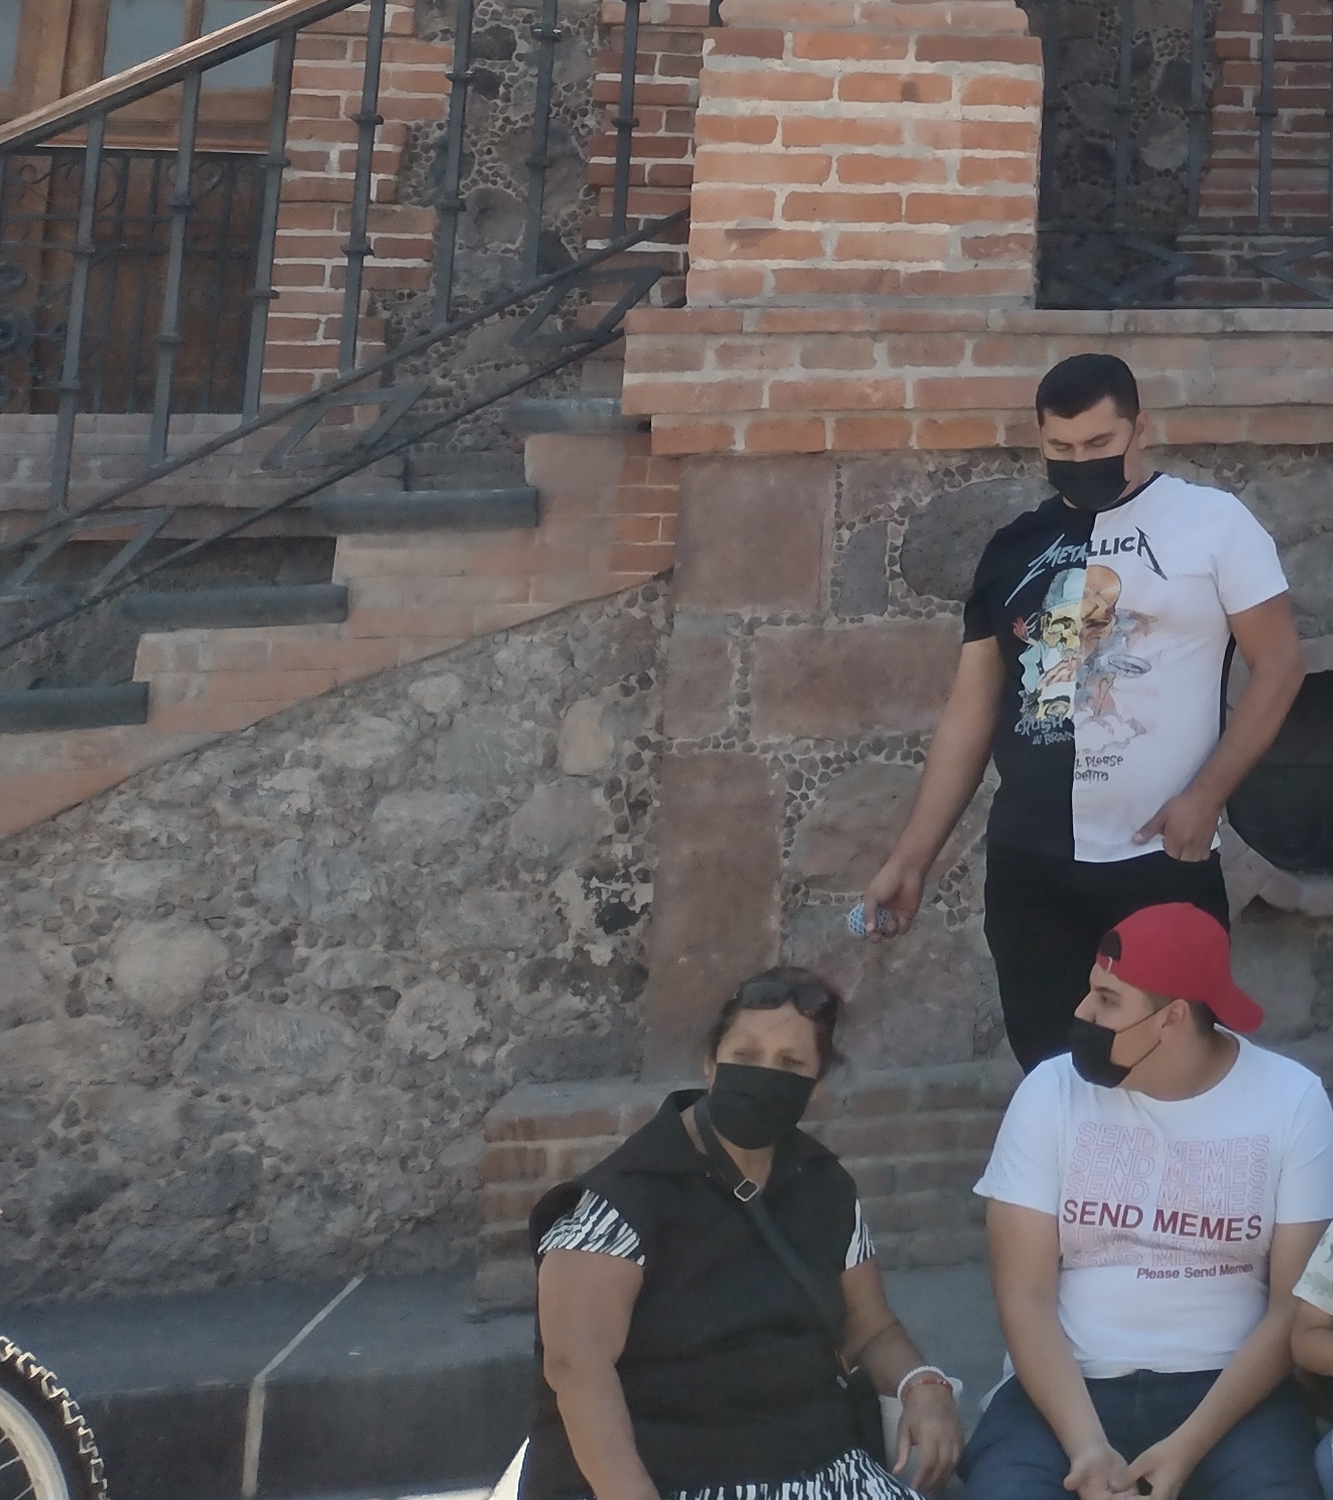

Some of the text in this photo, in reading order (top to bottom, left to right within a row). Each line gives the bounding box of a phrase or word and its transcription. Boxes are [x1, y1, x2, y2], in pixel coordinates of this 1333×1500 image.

[1004, 525, 1168, 607] METALLICA
[1076, 1121, 1158, 1152] SEND
[1069, 1146, 1156, 1180] SEND
[1064, 1172, 1150, 1205] SEND
[1062, 1199, 1263, 1242] SEND MEMES
[1136, 1266, 1180, 1279] Please
[1184, 1263, 1217, 1278] Send
